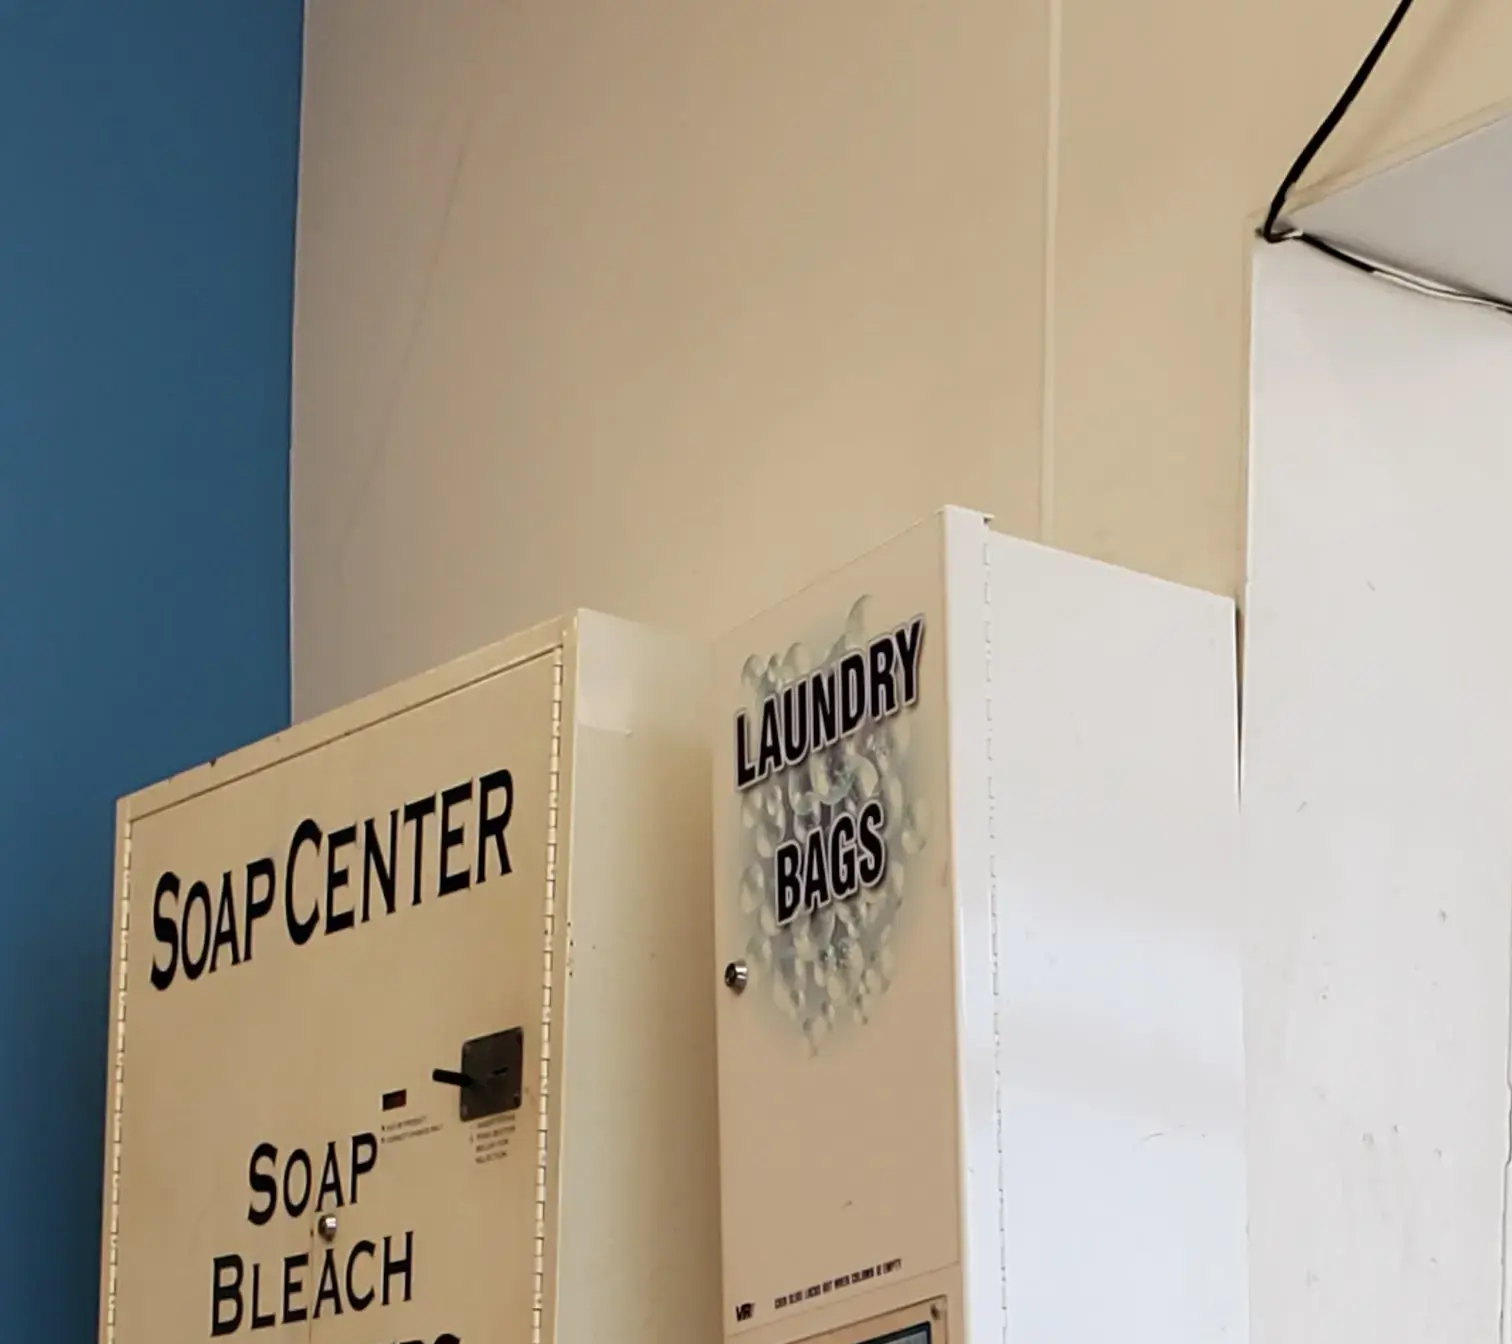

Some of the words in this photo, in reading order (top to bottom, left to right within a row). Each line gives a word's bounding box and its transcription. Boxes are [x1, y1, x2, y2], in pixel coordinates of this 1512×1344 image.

[735, 615, 924, 790] LAUNDRY
[775, 800, 886, 925] BAGS
[247, 1132, 378, 1226] SOAP
[210, 1231, 414, 1337] BLEACH
